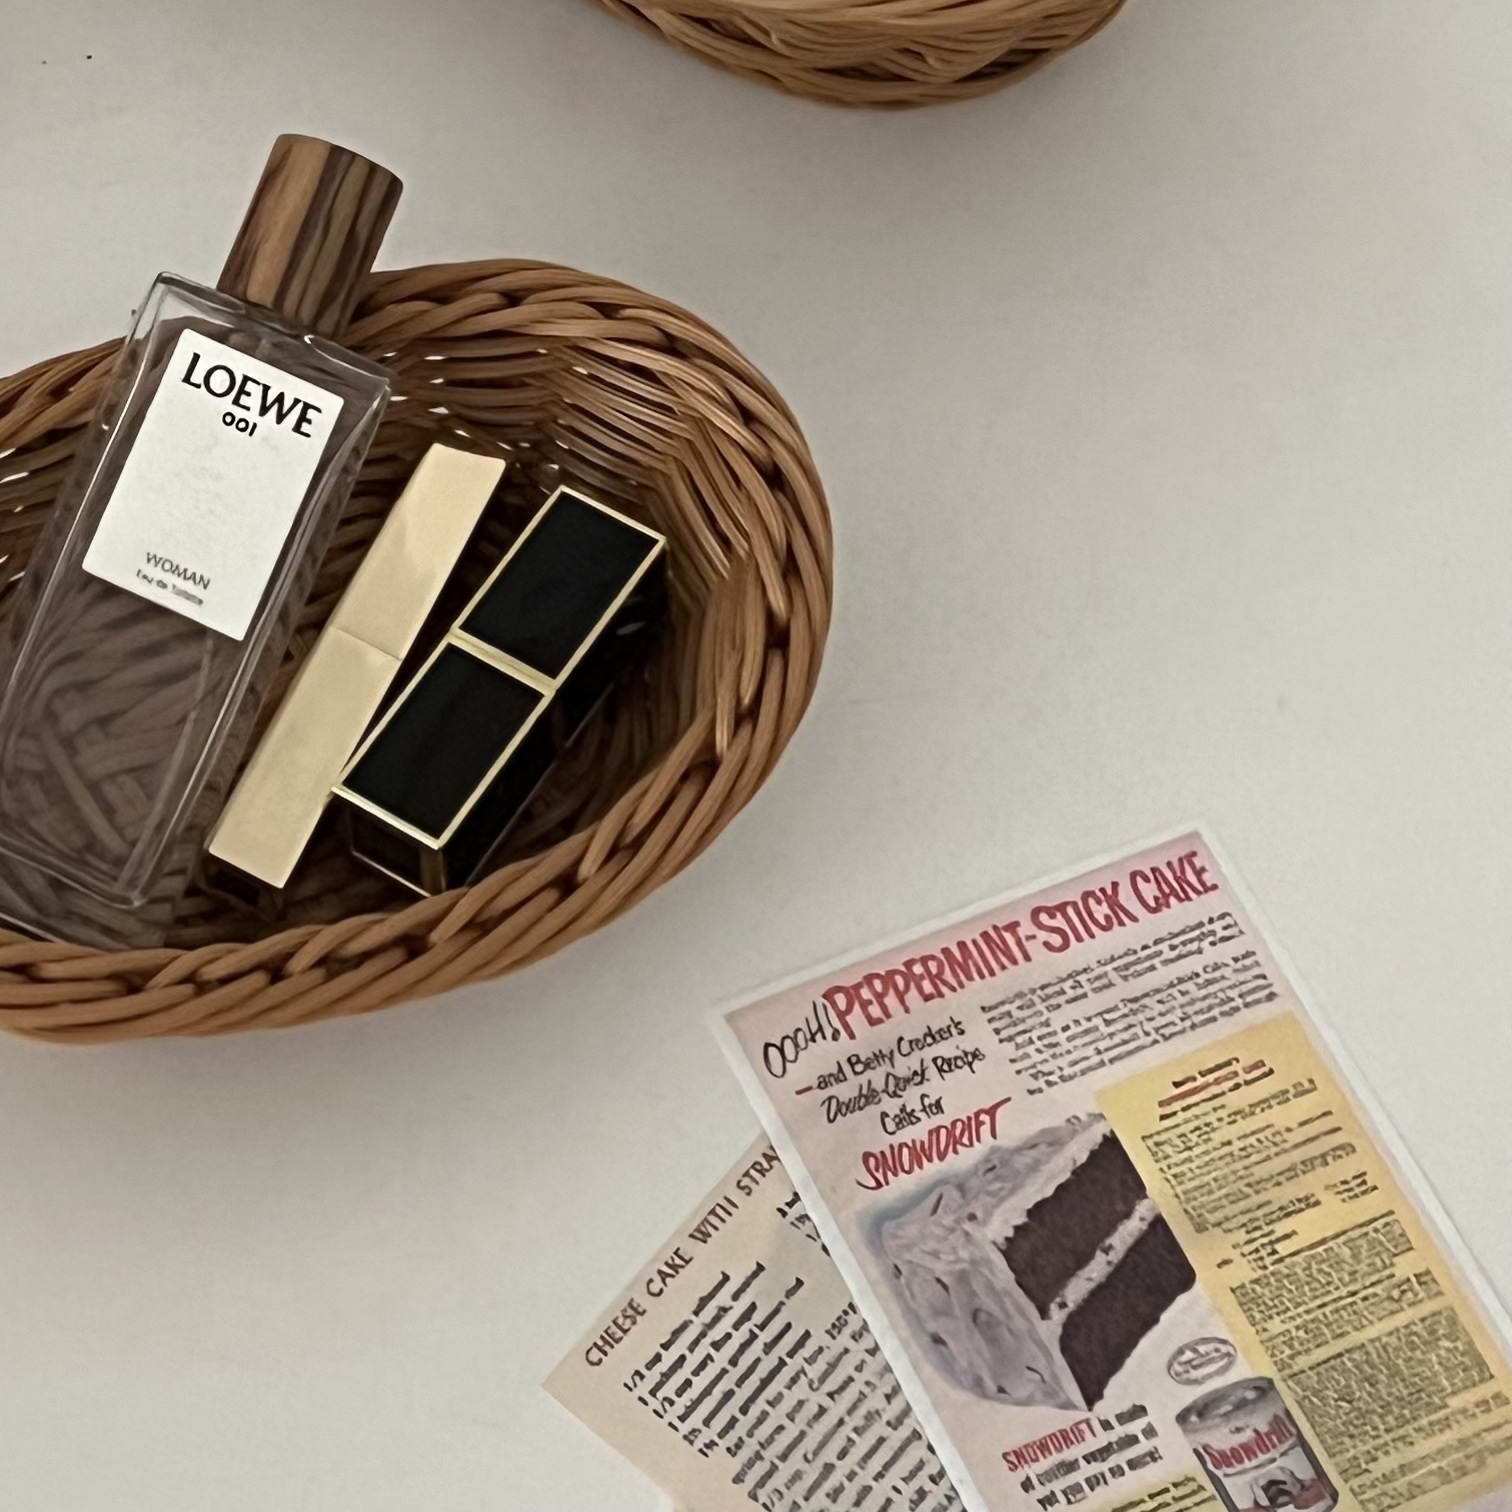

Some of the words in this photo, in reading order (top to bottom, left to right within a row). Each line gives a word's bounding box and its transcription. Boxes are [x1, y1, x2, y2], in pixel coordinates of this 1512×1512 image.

[181, 352, 323, 439] LOEWE
[221, 411, 257, 437] 001
[145, 551, 211, 591] WOMAN
[1129, 850, 1219, 914] CAKE
[847, 1047, 895, 1077] Betty
[919, 1092, 946, 1116] for
[855, 1096, 1012, 1190] SNOWDRIFT
[585, 1297, 647, 1367] CHEESE
[646, 1246, 694, 1298] CAKE
[687, 1195, 740, 1244] WITH
[1001, 1416, 1098, 1474] SNOWDRIFT
